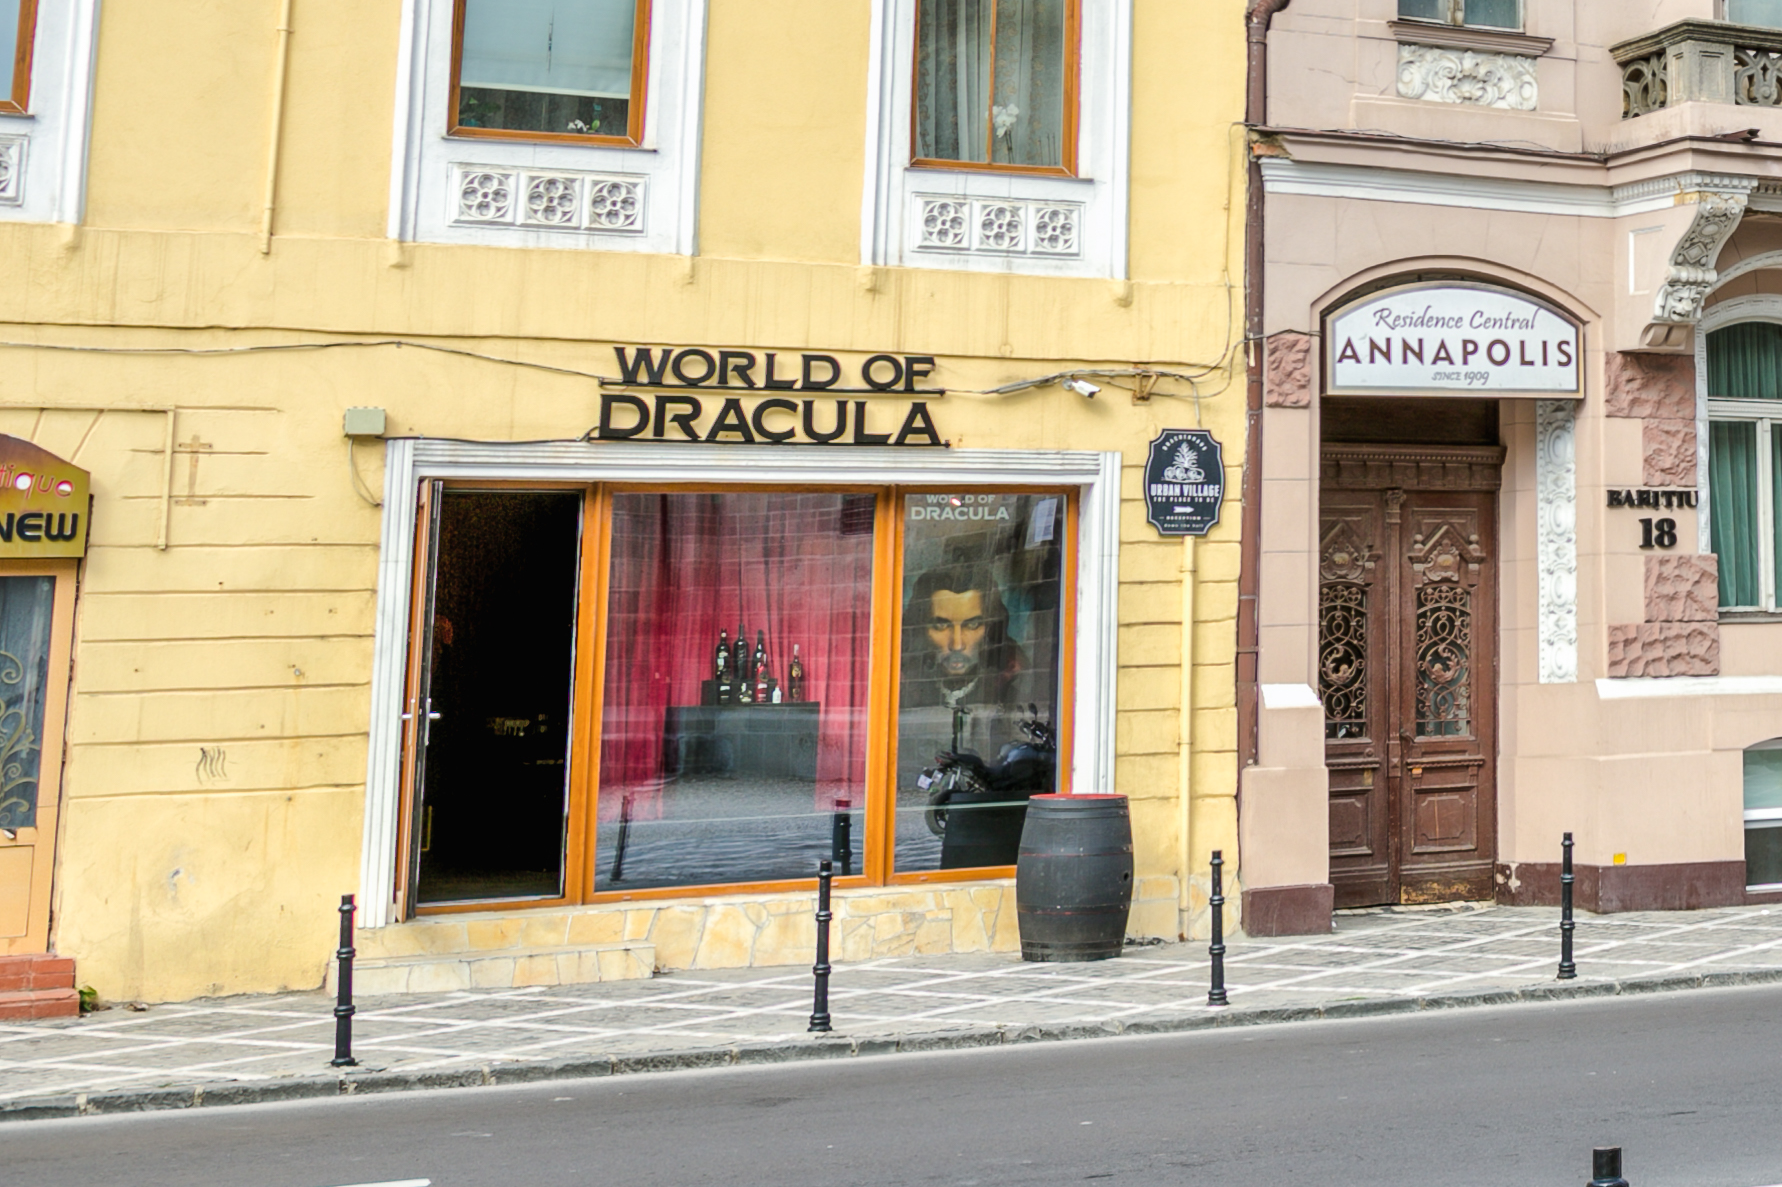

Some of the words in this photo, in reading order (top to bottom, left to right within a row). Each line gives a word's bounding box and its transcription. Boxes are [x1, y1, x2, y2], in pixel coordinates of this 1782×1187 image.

[1374, 305, 1463, 330] Residence
[1469, 307, 1543, 330] Central
[1337, 336, 1572, 367] ANNAPOLIS
[613, 347, 841, 389] WORLD
[861, 354, 936, 391] OF
[1464, 371, 1490, 386] 1909
[600, 394, 942, 444] DRACULA
[977, 494, 996, 504] OF
[1150, 483, 1181, 496] URBAN
[1182, 484, 1220, 497] VILLAGE
[911, 506, 1010, 521] DRACULA
[1638, 517, 1678, 550] 18
